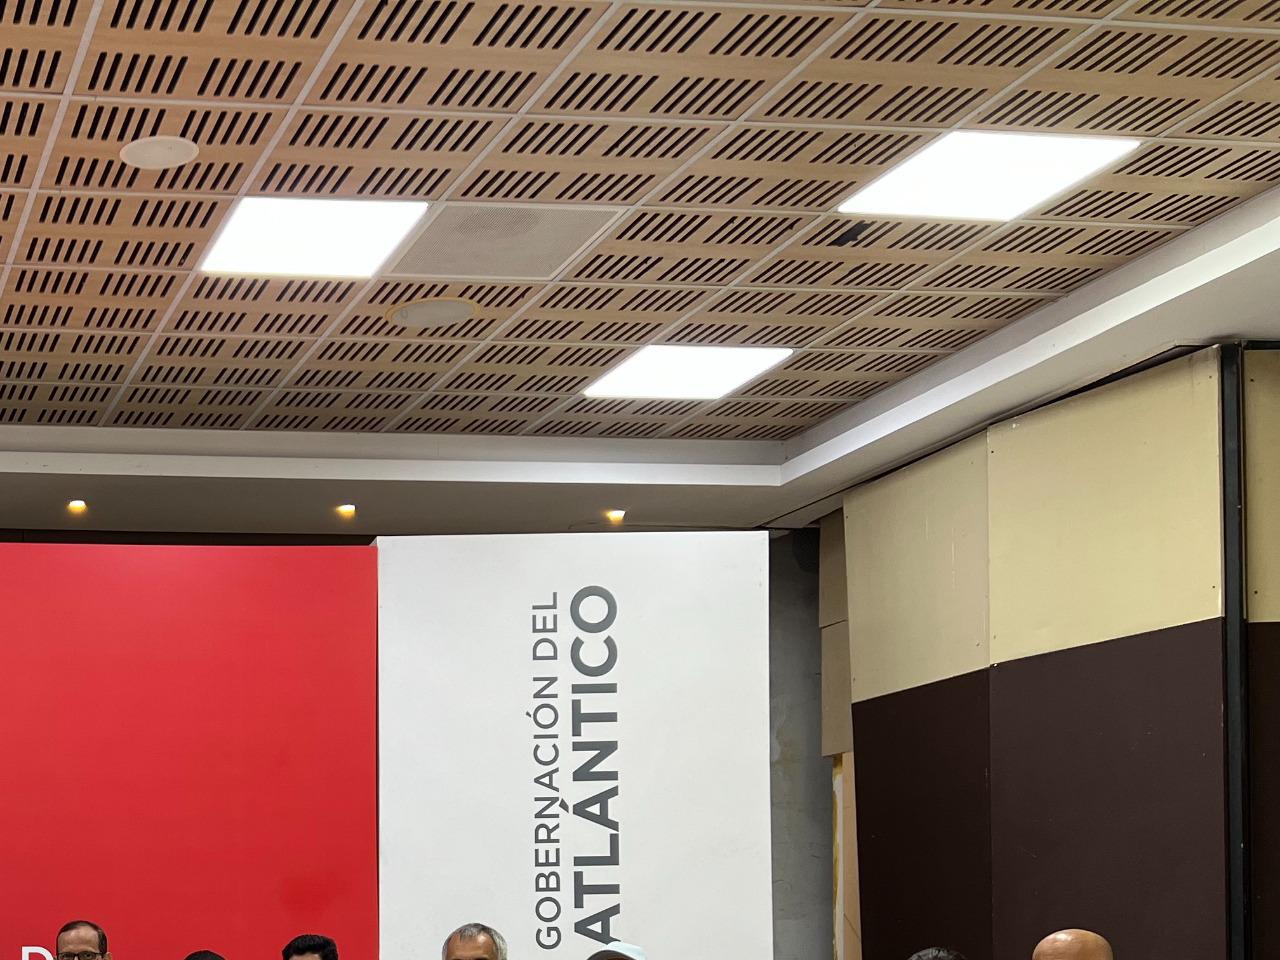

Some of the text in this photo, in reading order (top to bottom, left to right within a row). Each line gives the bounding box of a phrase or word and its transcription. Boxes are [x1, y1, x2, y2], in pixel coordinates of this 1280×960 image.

[525, 591, 562, 950] GOBERNACIÓN DEL
[558, 585, 621, 945] ATLÁNTICO
